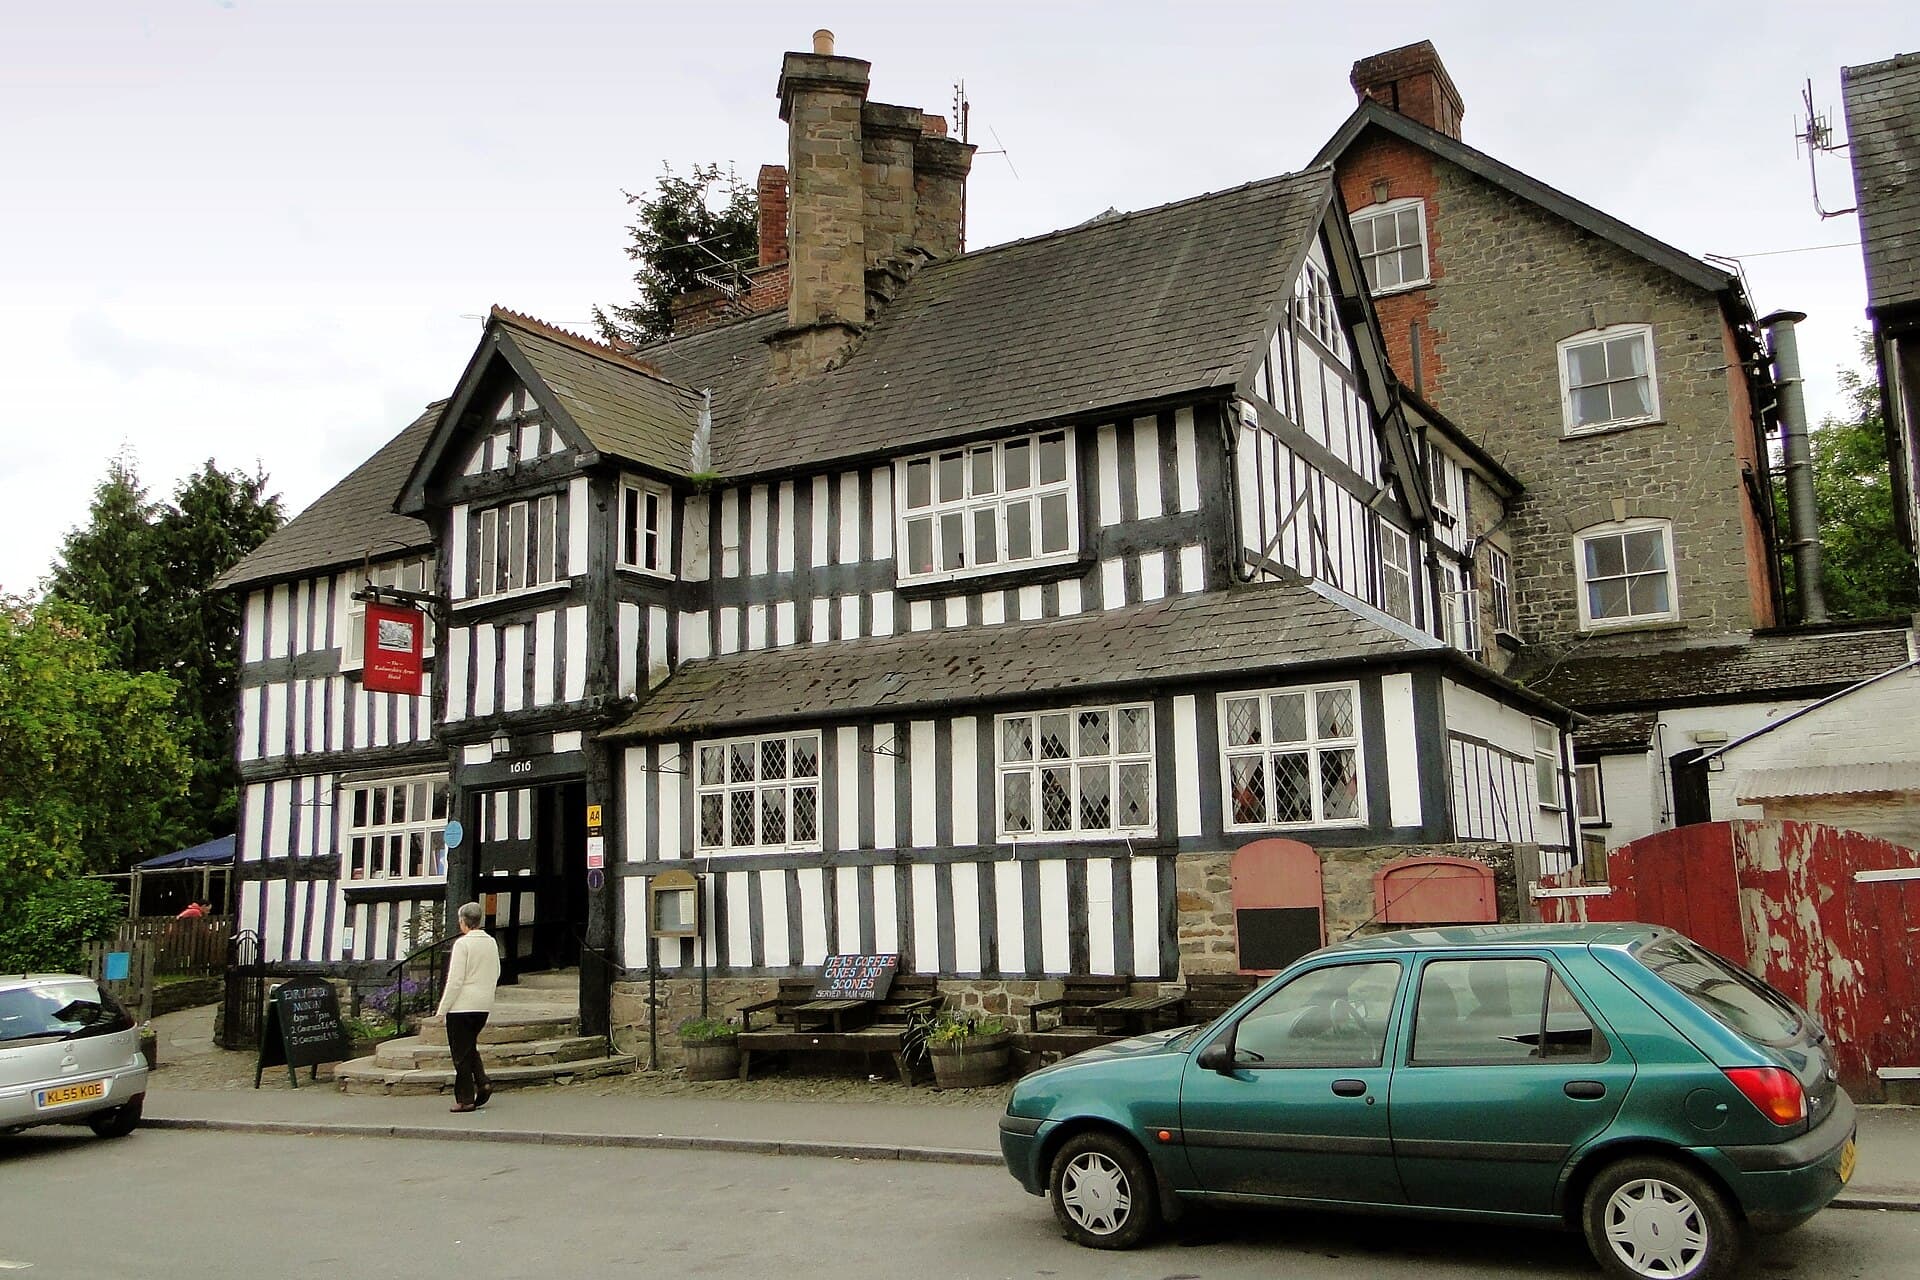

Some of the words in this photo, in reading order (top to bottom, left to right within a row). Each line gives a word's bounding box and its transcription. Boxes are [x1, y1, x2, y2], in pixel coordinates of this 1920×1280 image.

[510, 760, 532, 773] 1616
[589, 811, 600, 822] AA
[827, 956, 854, 968] TEAS
[855, 956, 897, 967] COFFEE
[825, 967, 857, 979] CAKES
[857, 967, 882, 978] AND
[831, 978, 875, 990] SCONES
[292, 1036, 299, 1045] 3
[48, 1088, 77, 1103] KL55
